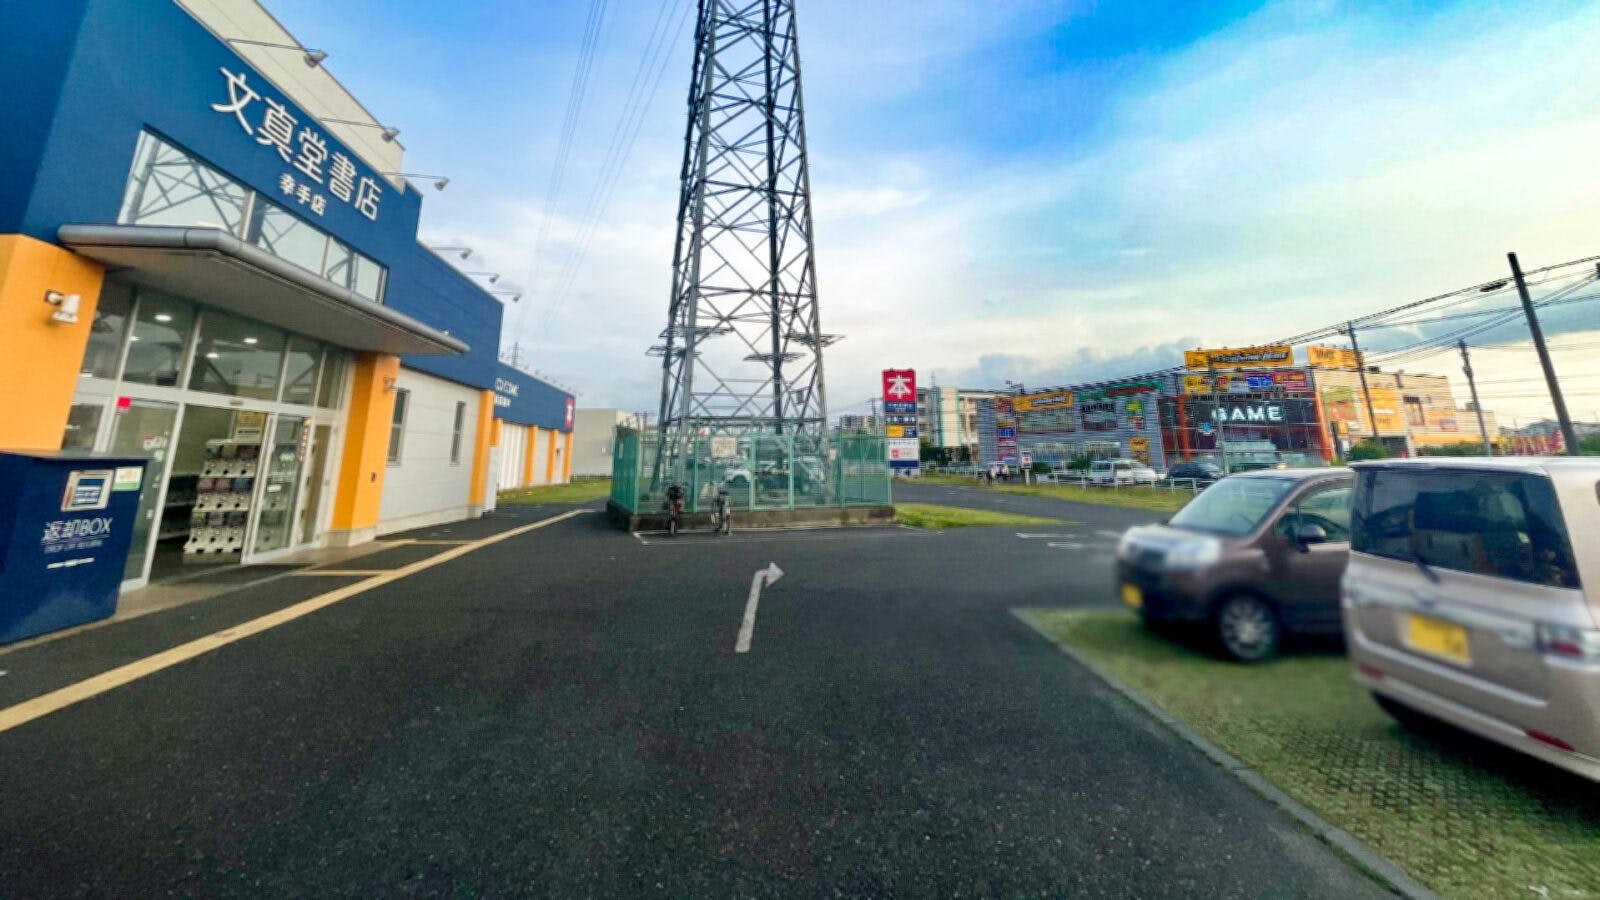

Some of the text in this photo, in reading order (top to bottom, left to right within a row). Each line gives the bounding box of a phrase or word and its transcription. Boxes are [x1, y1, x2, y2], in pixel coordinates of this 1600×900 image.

[211, 67, 382, 221] 文真堂書店
[279, 173, 326, 216] 幸手店
[887, 375, 912, 400] 本
[1211, 405, 1284, 422] GAME
